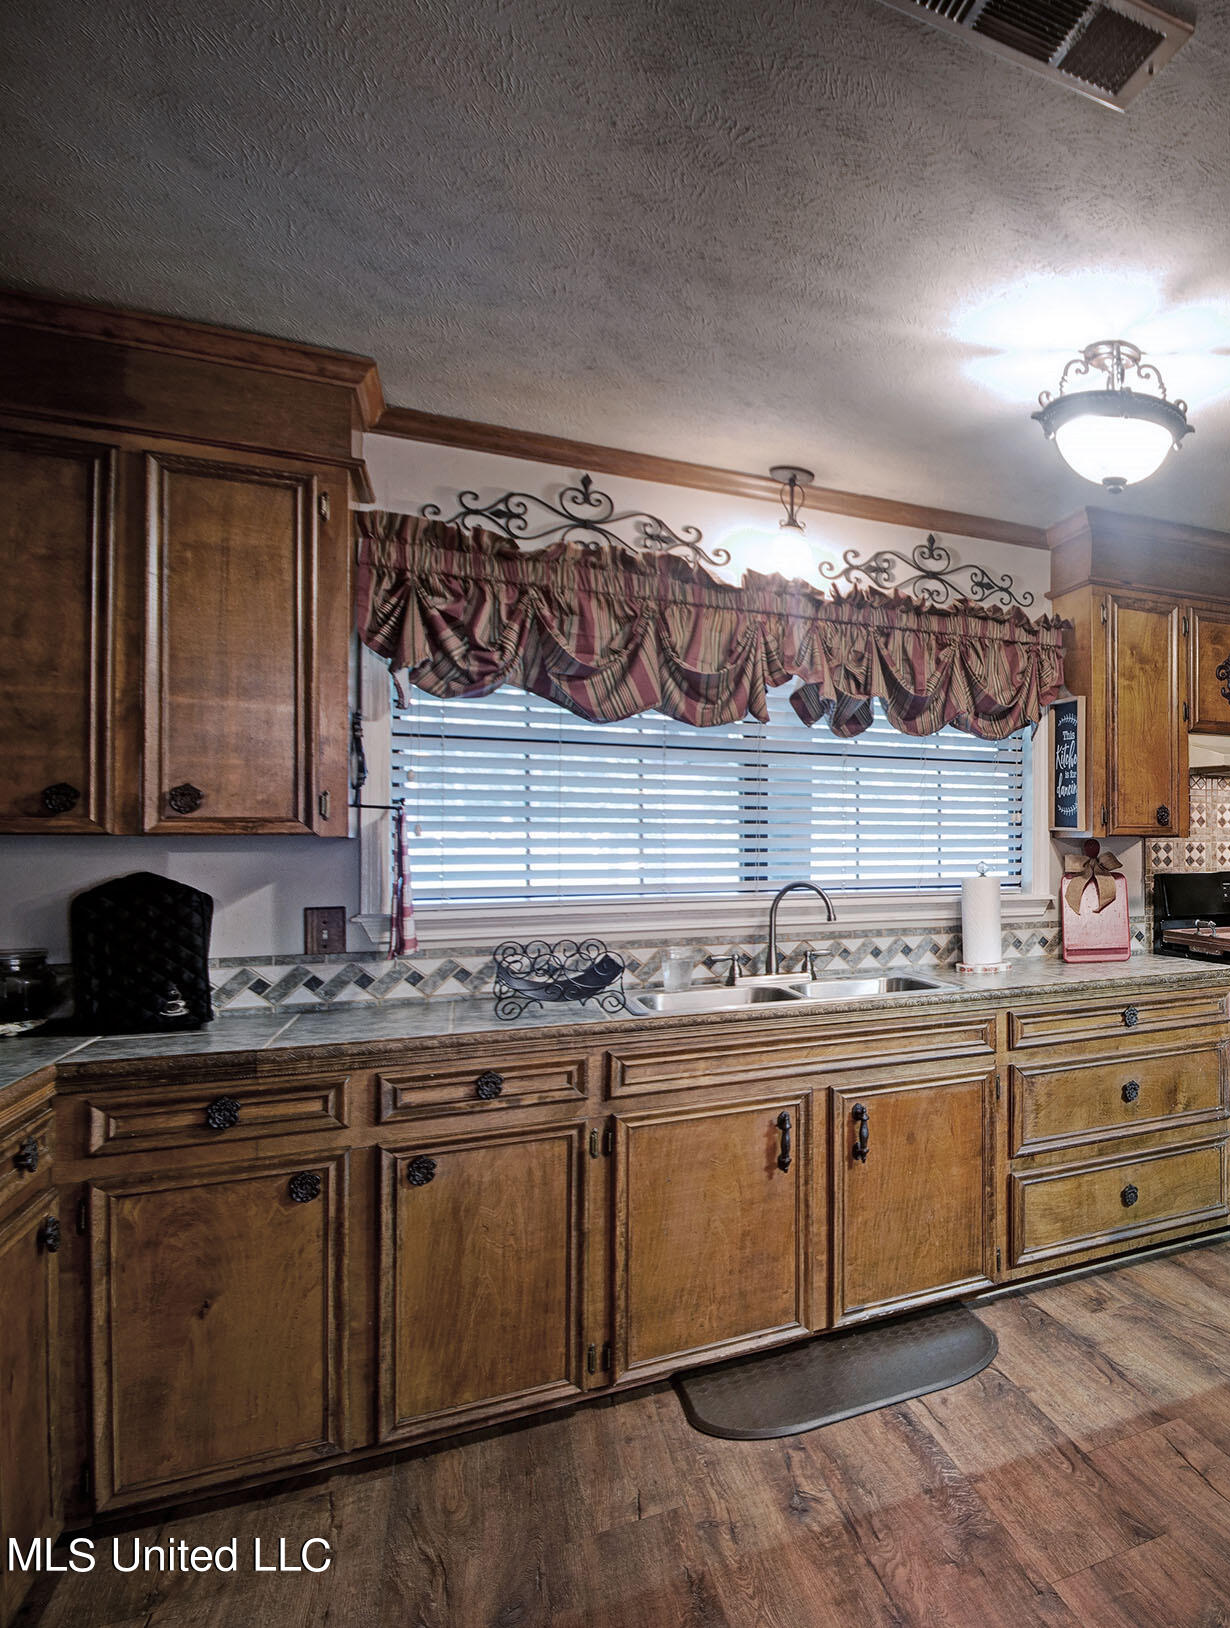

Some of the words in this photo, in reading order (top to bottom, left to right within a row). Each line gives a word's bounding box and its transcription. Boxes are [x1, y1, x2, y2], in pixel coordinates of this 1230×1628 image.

[1062, 730, 1075, 740] This
[1055, 740, 1077, 770] Kitche
[1056, 772, 1077, 798] dancin
